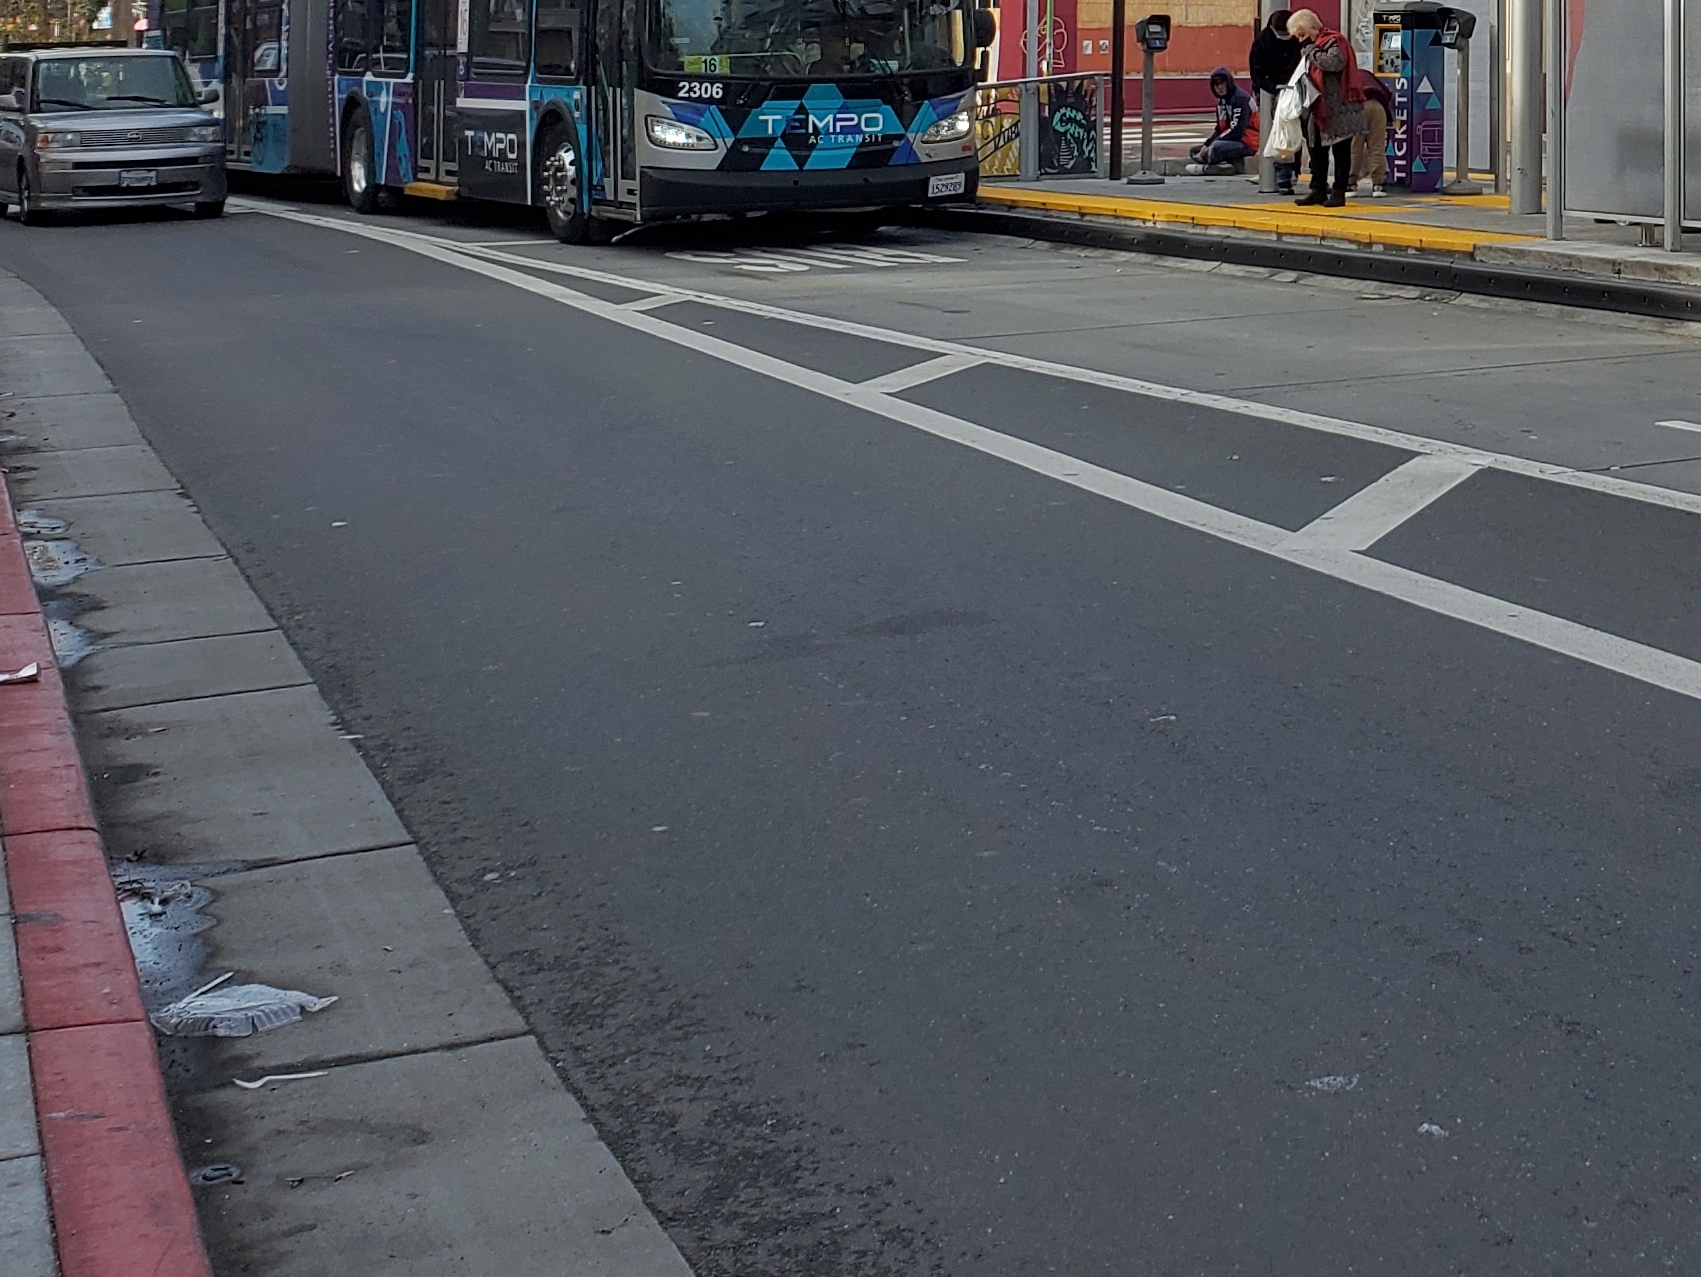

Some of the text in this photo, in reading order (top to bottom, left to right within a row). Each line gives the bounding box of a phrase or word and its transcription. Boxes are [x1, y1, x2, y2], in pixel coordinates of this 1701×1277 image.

[701, 57, 717, 73] 16
[677, 81, 724, 99] 2306
[758, 112, 884, 135] TEMPO
[1393, 77, 1409, 183] TICKETS
[808, 133, 884, 144] AC TRANSIT
